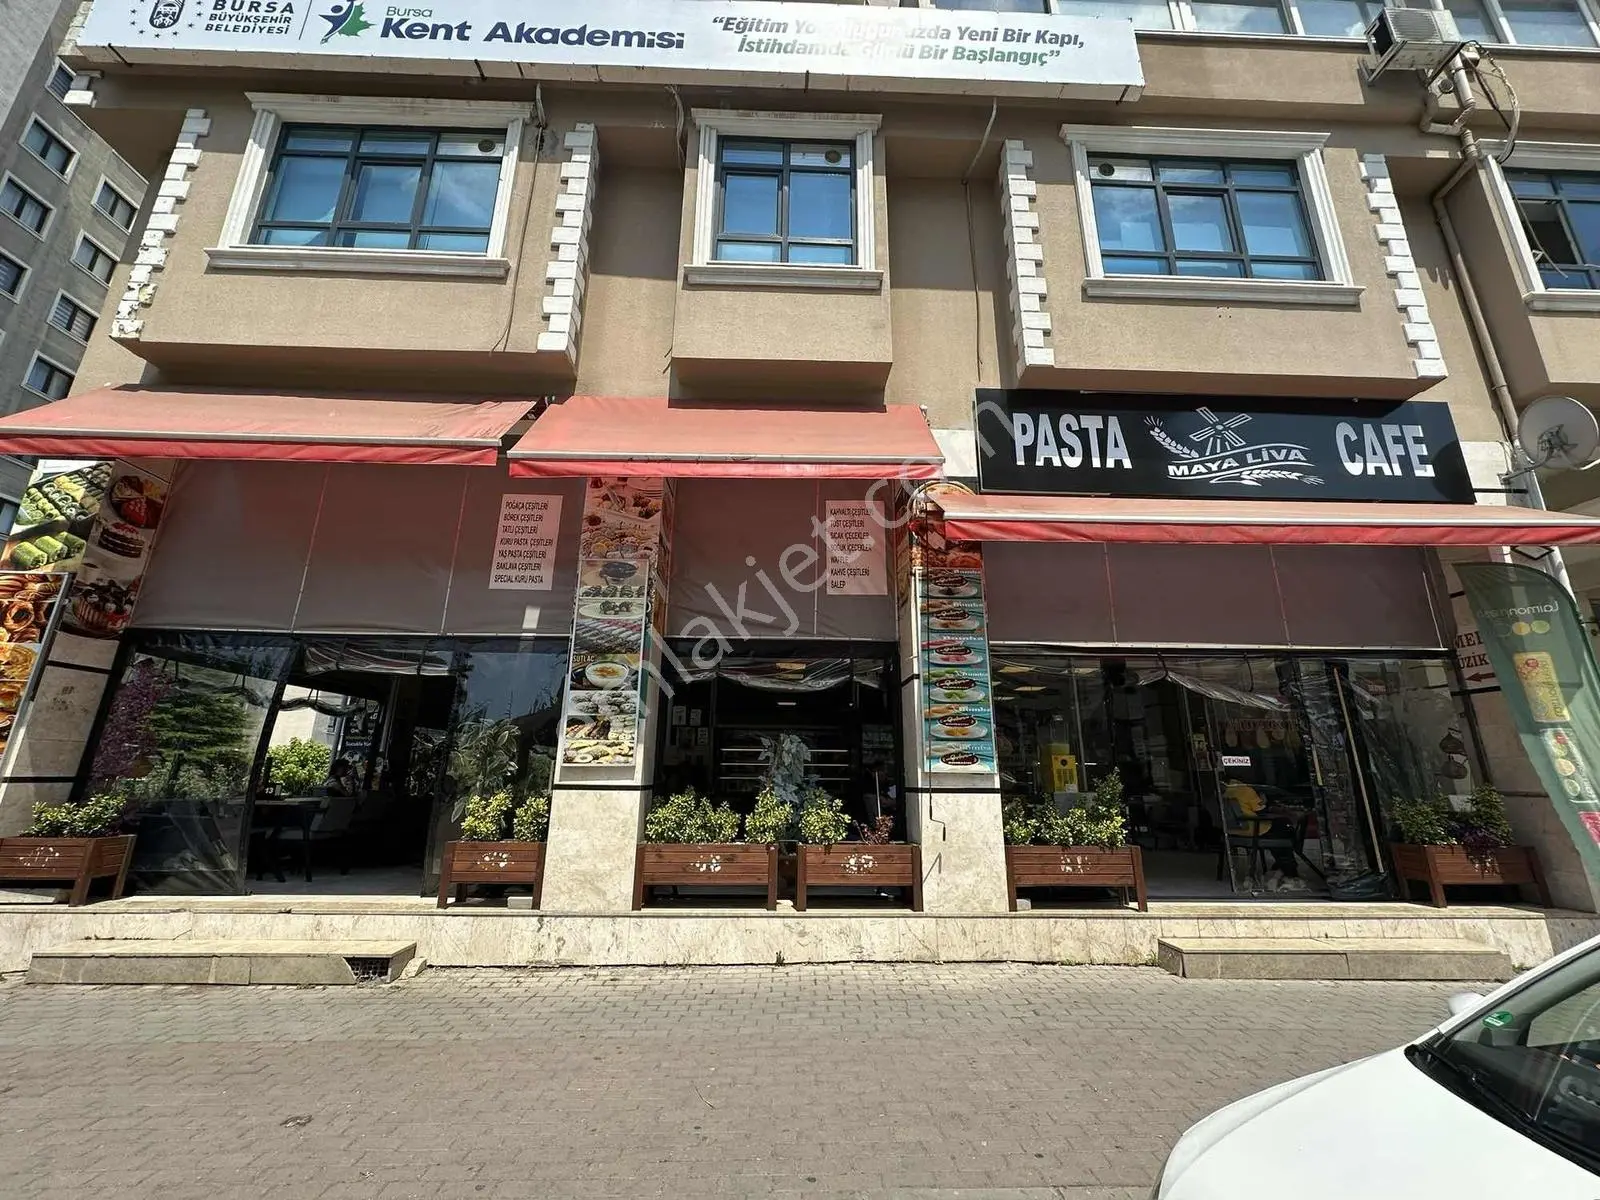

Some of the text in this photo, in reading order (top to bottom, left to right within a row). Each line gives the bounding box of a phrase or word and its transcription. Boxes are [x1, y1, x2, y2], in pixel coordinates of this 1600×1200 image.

[212, 0, 294, 14] BURSA
[386, 6, 433, 18] Bursa
[208, 13, 292, 25] BÜYÜKŞEHİR
[205, 23, 290, 35] BELEDİYESİ
[381, 18, 685, 49] Kent Akademisi
[957, 26, 999, 43] Yeni
[1002, 28, 1031, 44] Bir
[1034, 30, 1084, 49] Kapı,
[919, 44, 948, 60] Bir
[952, 46, 1061, 66] Başlangıç”
[1013, 412, 1133, 469] PASTA
[1334, 421, 1435, 478] CAFE
[1167, 457, 1239, 476] MAYA
[513, 538, 528, 546] PASTA
[830, 580, 846, 588] SALEP
